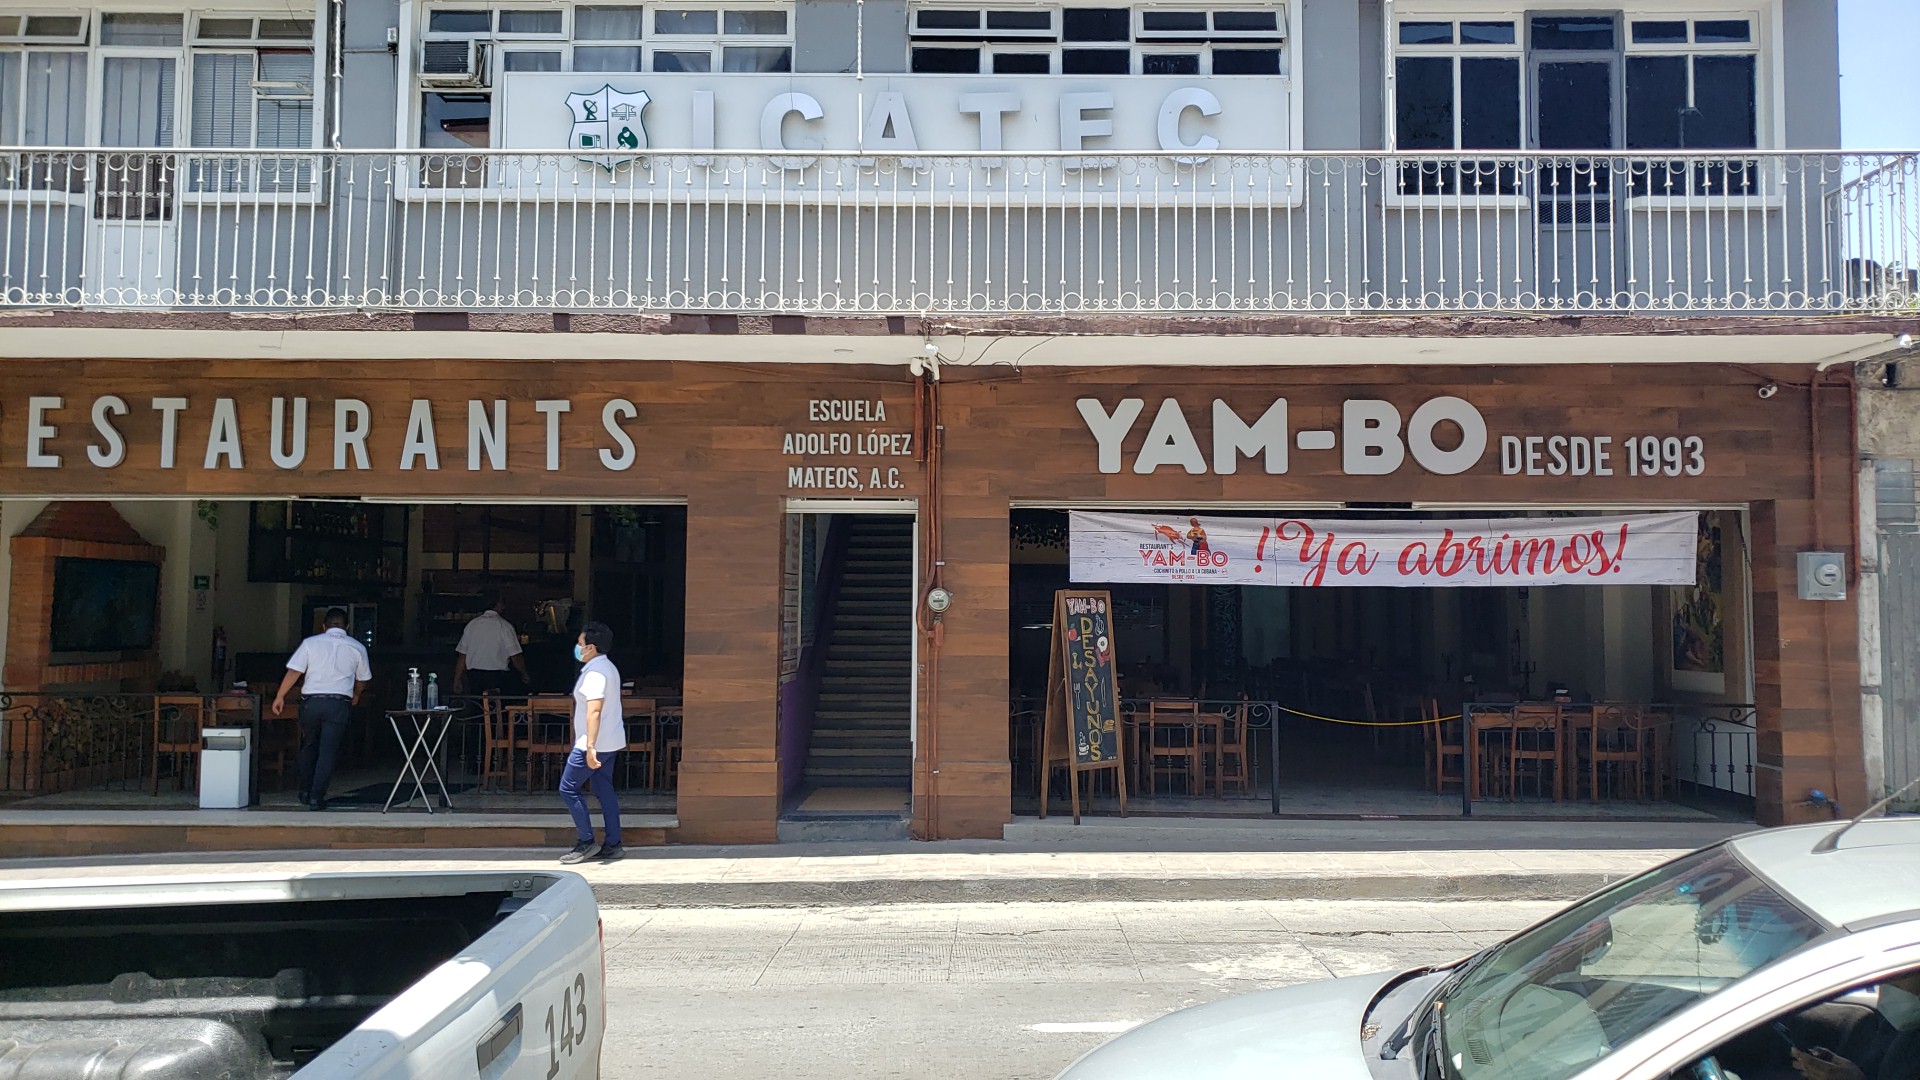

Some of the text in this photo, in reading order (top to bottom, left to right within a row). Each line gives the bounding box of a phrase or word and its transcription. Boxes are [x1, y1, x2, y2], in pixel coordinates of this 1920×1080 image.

[693, 87, 1222, 169] ICATEC
[26, 395, 639, 471] ESTAURANTS
[808, 399, 887, 422] ESCUELA
[1076, 396, 1706, 477] YAM-BO DESDE 1993
[782, 428, 912, 456] ADOLFO LÓPEZ
[788, 467, 905, 492] MATEOS, A.C.
[1139, 549, 1229, 568] YAM-BO
[1397, 523, 1629, 577] abrimos!
[1066, 597, 1106, 616] YAM-BO
[1080, 616, 1103, 762] DESAYUNOS
[545, 972, 587, 1080] 143
